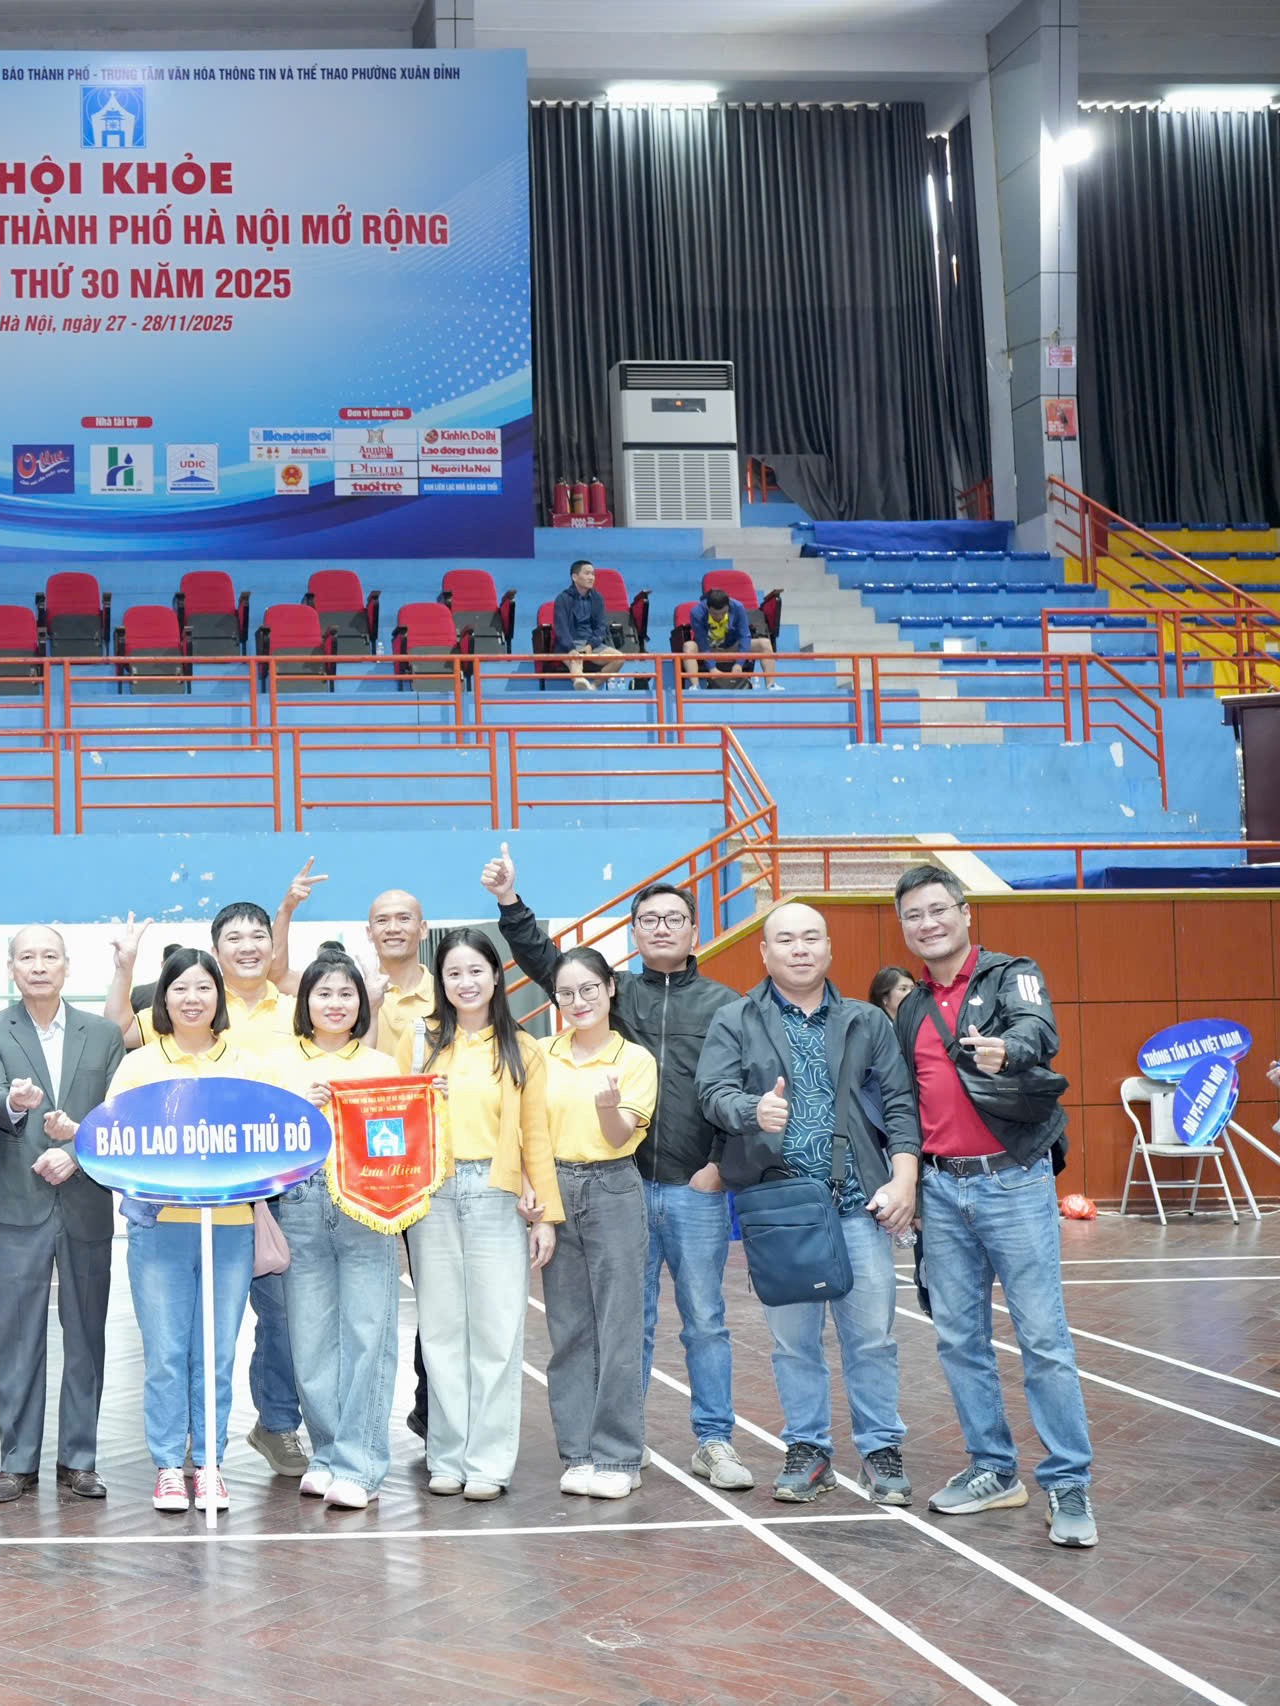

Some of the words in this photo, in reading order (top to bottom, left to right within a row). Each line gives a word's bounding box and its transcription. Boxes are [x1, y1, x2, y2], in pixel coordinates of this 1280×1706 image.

[2, 66, 24, 81] BÁO
[28, 66, 64, 81] THÀNH
[68, 63, 90, 81] PHỐ
[101, 68, 138, 81] TRUNG
[141, 66, 164, 81] TÂM
[168, 66, 190, 81] VĂN
[193, 66, 216, 81] HÓA
[219, 66, 255, 80] THÔNG
[259, 68, 276, 80] TIN
[280, 66, 294, 80] VÀ
[297, 63, 317, 80] THỂ
[320, 68, 348, 80] THAO
[351, 64, 397, 80] PHƯỜNG
[400, 66, 430, 80] XUÂN
[433, 63, 460, 80] ĐỈNH
[102, 152, 232, 194] KHỎE
[109, 204, 172, 245] PHỐ
[183, 208, 225, 245] HÀ
[236, 208, 290, 251] NỘI
[302, 204, 352, 245] MỞ
[362, 208, 448, 251] RỘNG
[11, 262, 74, 299] THỨ
[81, 268, 119, 299] 30
[130, 262, 204, 299] NĂM
[215, 268, 292, 299] 2025
[0, 315, 20, 332] Hà
[25, 314, 57, 335] Nội,
[62, 315, 102, 333] ngày
[105, 315, 127, 332] 27
[142, 314, 233, 332] 28/11/2025
[95, 416, 112, 426] Nhà
[113, 416, 125, 426] tài
[126, 417, 138, 428] trợ
[372, 409, 391, 417] tham
[392, 409, 404, 418] gia
[180, 460, 206, 468] UDIC
[1143, 1049, 1172, 1068] THÔNG
[1170, 1041, 1190, 1061] TẤN
[1187, 1039, 1203, 1057] XÃ
[1199, 1035, 1220, 1054] VIỆT
[1219, 1030, 1243, 1049] NAM
[1208, 1064, 1228, 1086] NỘI
[1201, 1079, 1218, 1098] HÀ
[1182, 1116, 1200, 1136] ĐÀI
[96, 1121, 136, 1156] BÁO
[141, 1125, 178, 1156] LAO
[183, 1118, 237, 1161] ĐỘNG
[242, 1113, 279, 1153] THỦ
[284, 1116, 311, 1152] ĐÔ
